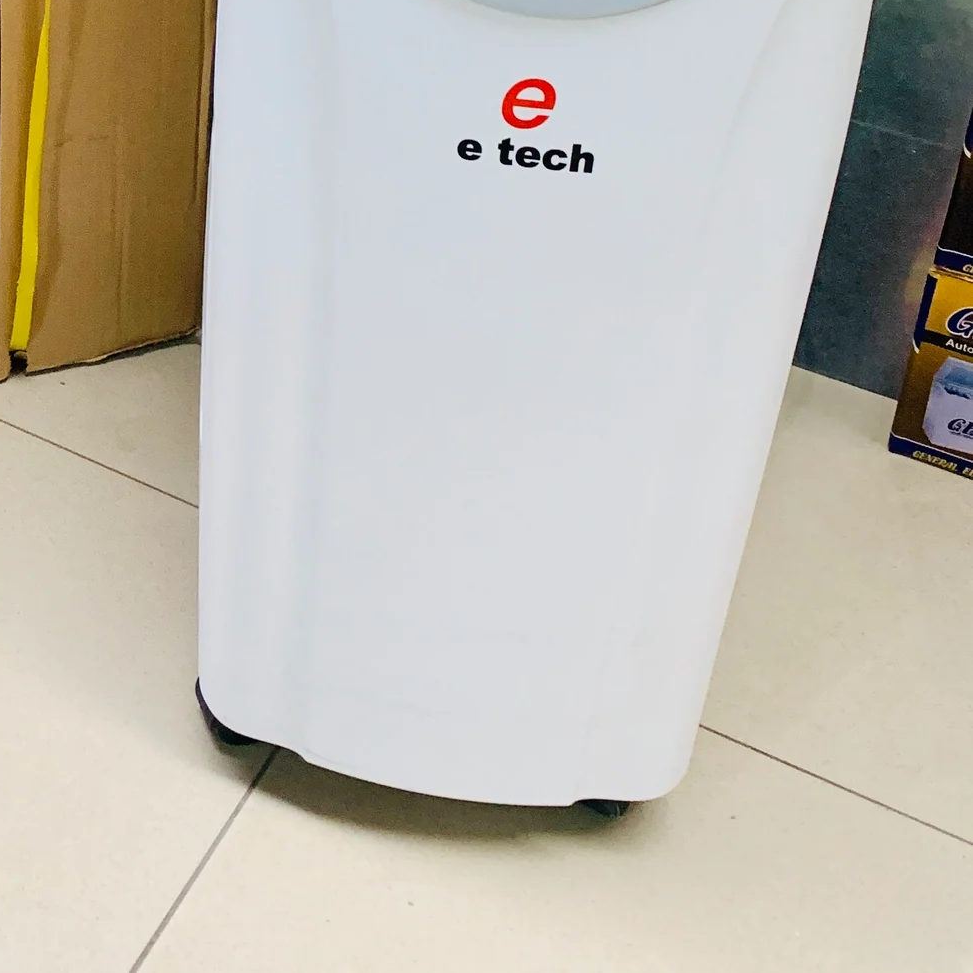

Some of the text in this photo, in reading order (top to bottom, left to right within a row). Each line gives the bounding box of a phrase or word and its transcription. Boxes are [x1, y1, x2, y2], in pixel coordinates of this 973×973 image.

[501, 78, 557, 130] e
[457, 137, 595, 174] e tech
